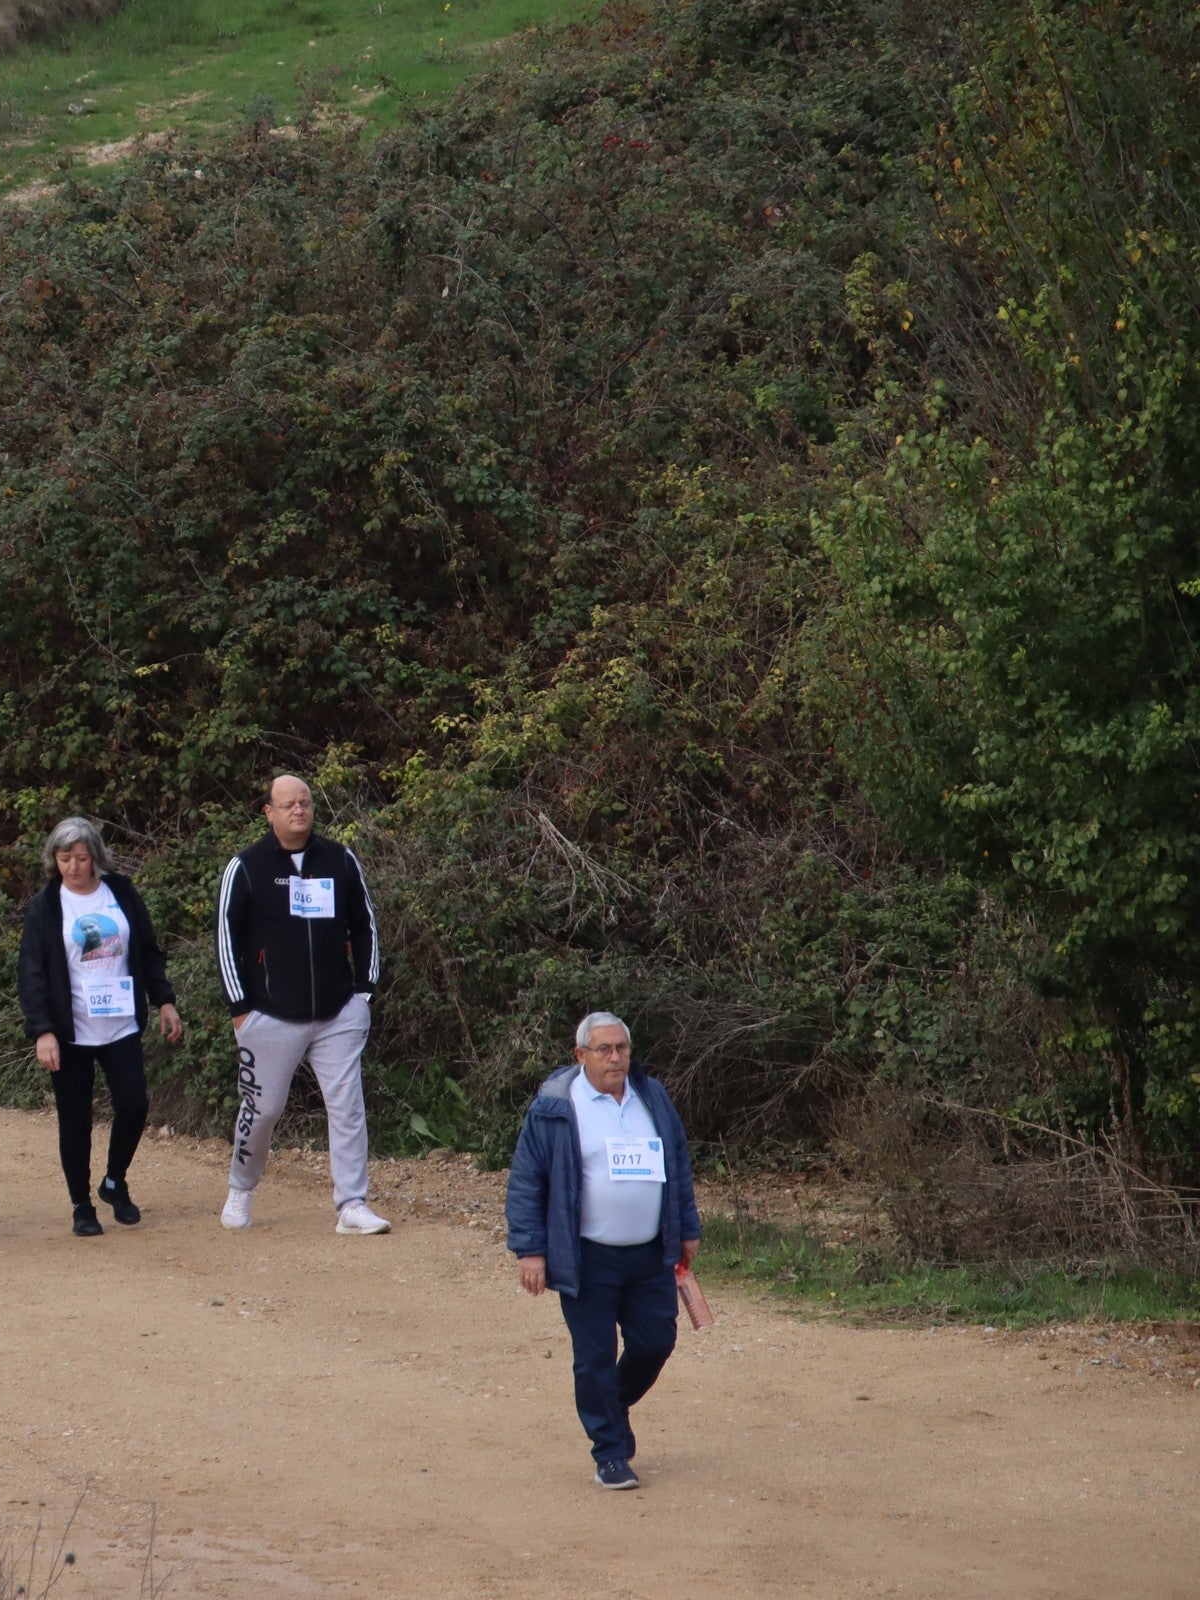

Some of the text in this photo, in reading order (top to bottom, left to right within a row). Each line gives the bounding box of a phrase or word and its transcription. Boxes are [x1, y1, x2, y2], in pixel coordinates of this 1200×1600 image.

[90, 994, 112, 1005] 0247
[238, 1046, 262, 1138] adidas
[612, 1153, 642, 1165] 0717
